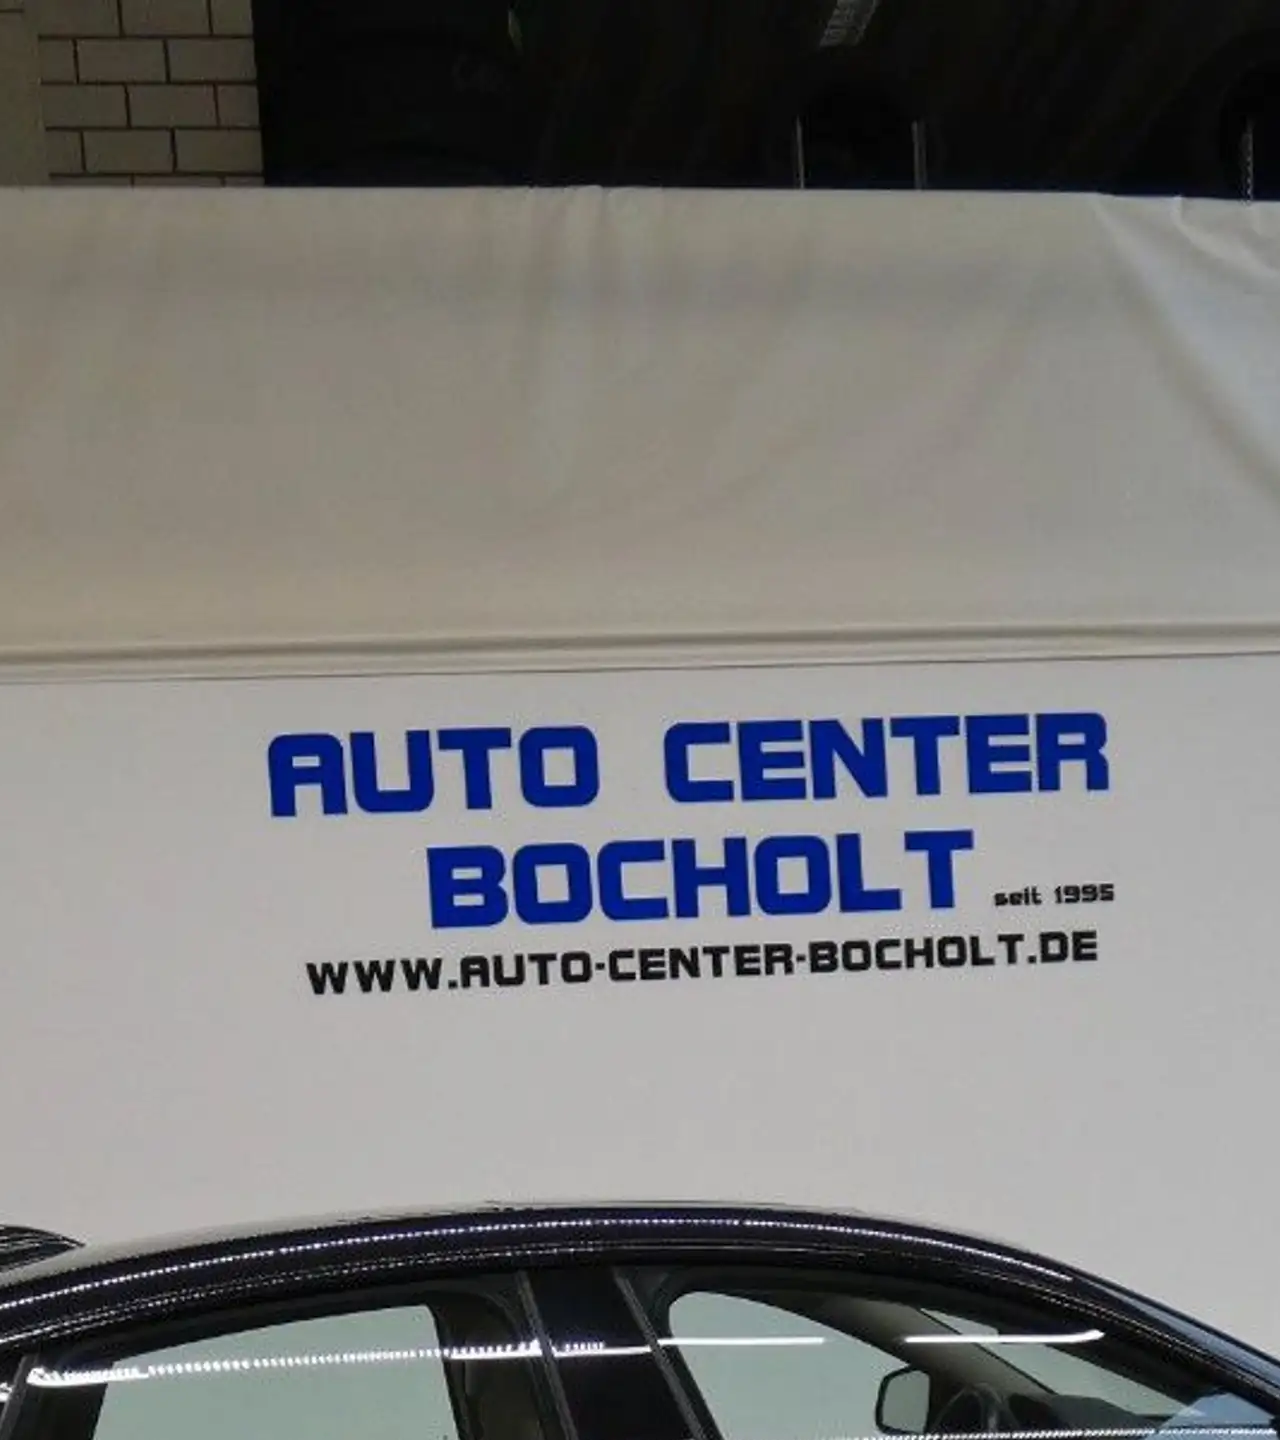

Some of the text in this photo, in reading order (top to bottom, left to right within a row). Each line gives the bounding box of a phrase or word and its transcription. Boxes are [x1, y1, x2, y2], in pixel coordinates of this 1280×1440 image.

[267, 711, 1110, 818] AUTO CENTER
[426, 829, 975, 930] BOCHOLT
[994, 882, 1115, 907] seit 1995
[306, 930, 1099, 996] WWW.AUTO-CENTER-BOCHOLT.DE
